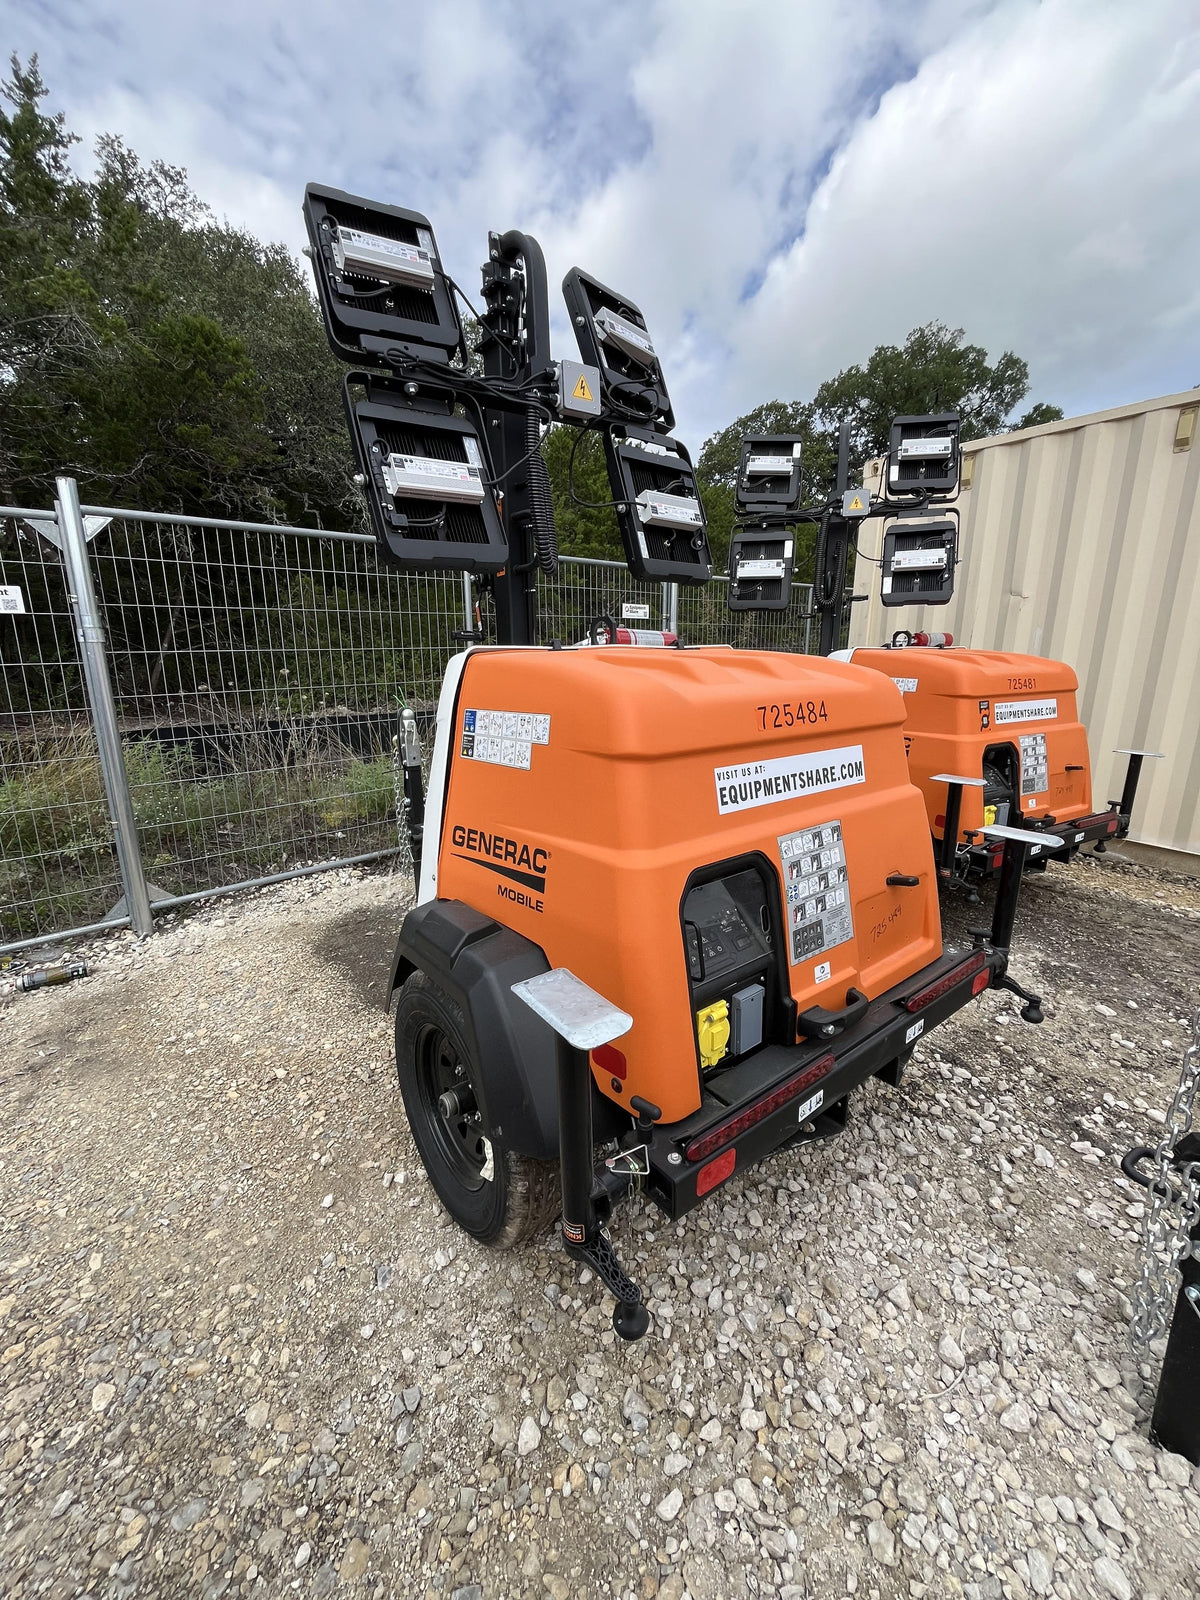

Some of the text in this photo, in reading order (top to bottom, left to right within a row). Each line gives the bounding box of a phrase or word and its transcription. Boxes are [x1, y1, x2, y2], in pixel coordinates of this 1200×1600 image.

[1008, 678, 1037, 690] 725481
[757, 700, 828, 730] 725484
[716, 765, 766, 781] VISIT US AT:
[719, 760, 864, 806] EQUIPMENTSHARE.COM
[452, 825, 547, 874] GENERAC
[497, 884, 544, 913] MOBILE
